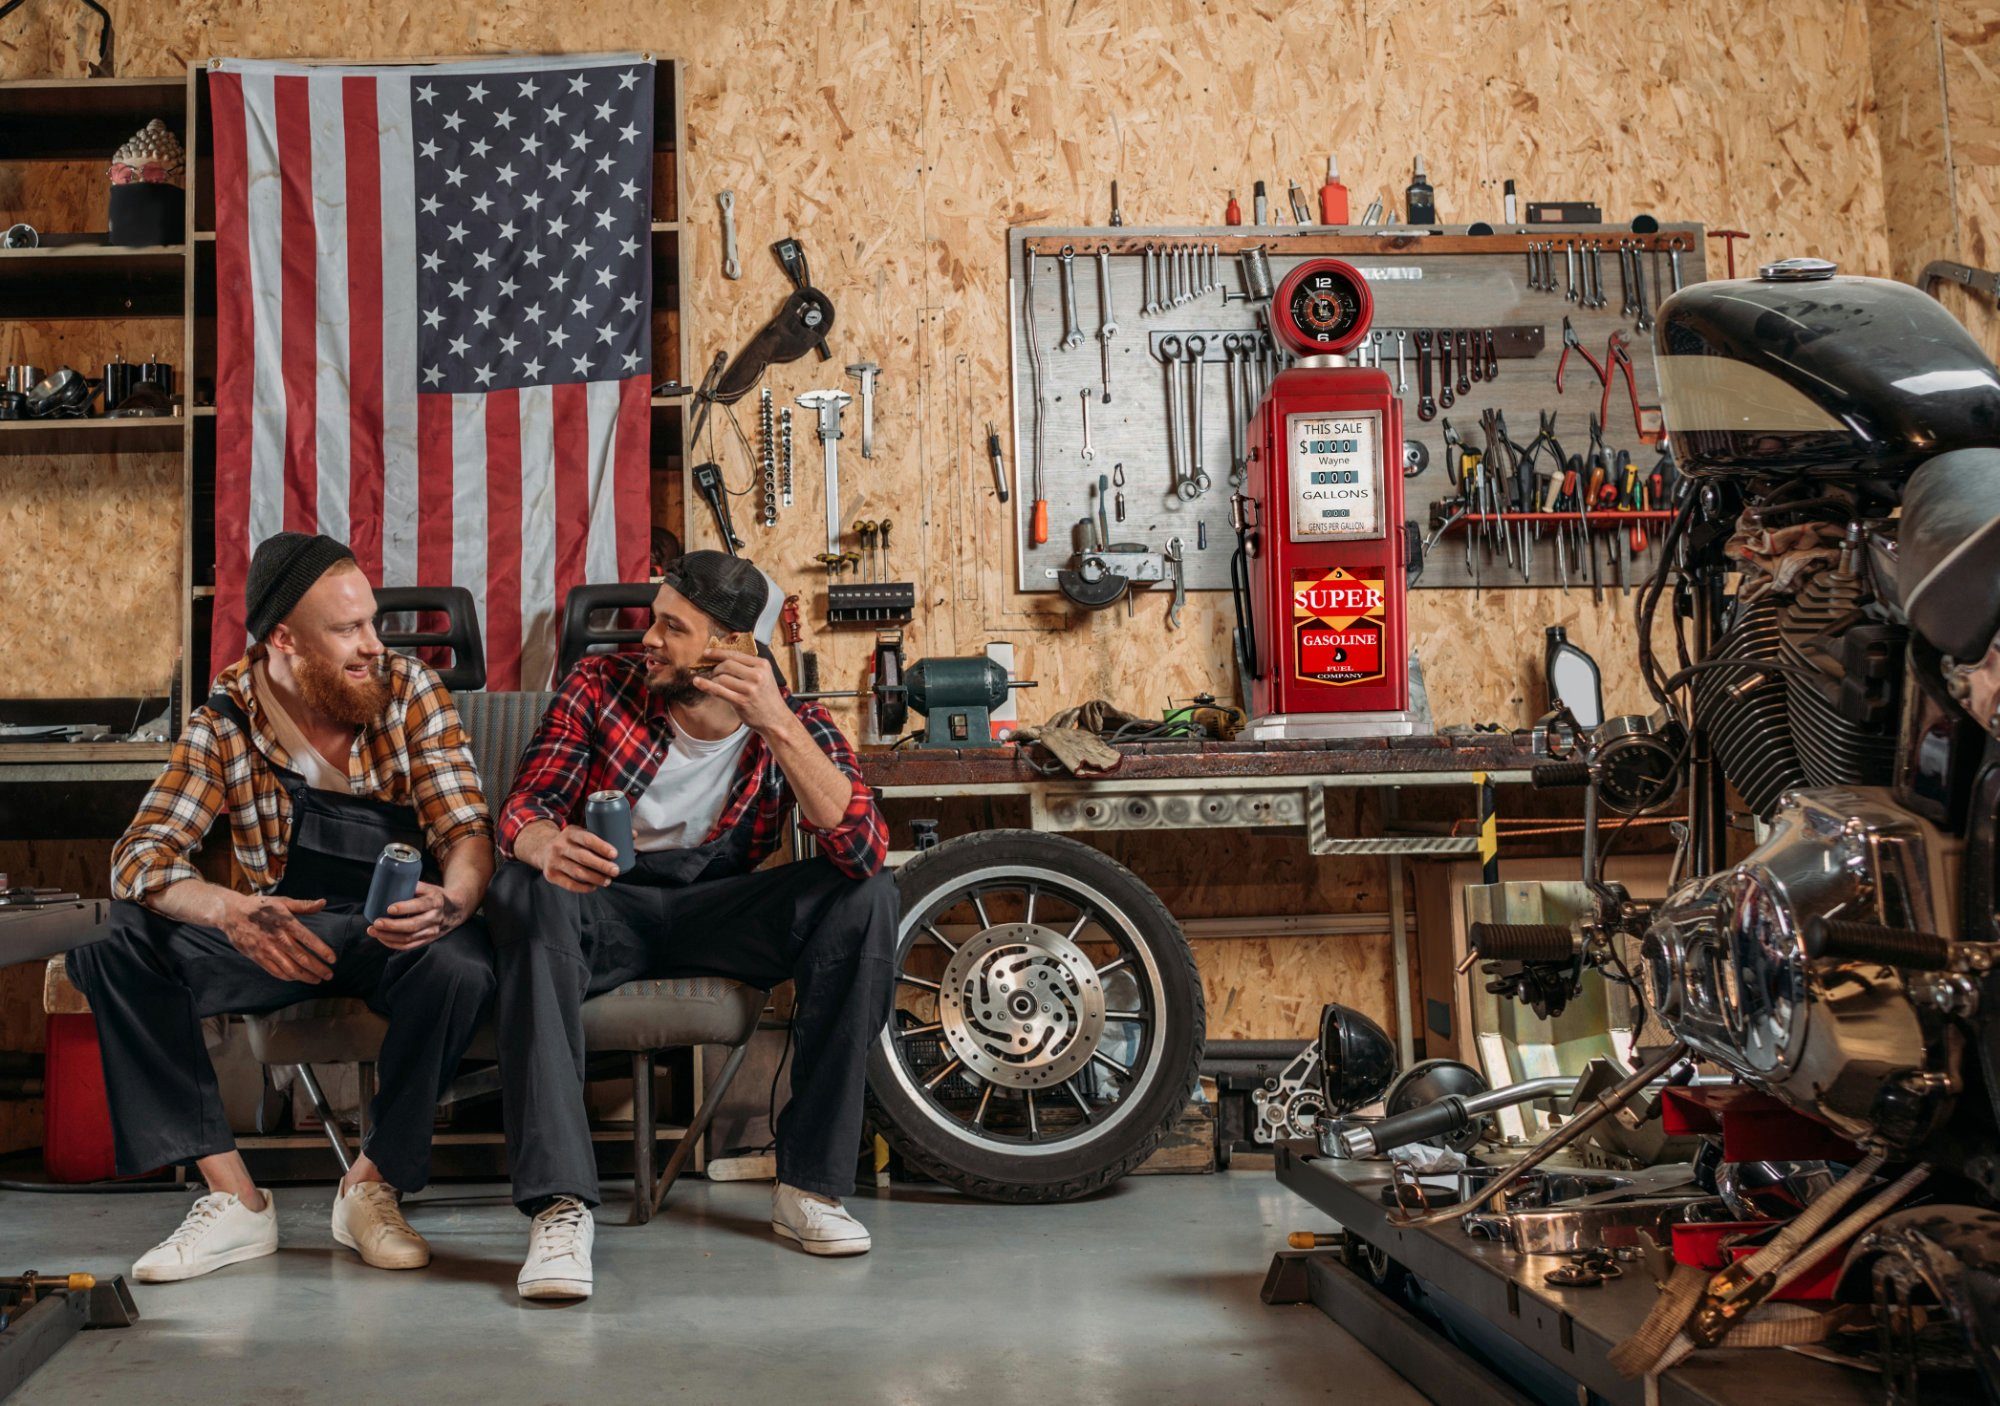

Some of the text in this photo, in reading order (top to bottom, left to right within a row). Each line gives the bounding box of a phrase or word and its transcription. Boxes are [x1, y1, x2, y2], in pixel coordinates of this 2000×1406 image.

[1315, 278, 1332, 288] 12
[1317, 333, 1330, 342] 6
[1304, 423, 1362, 435] THIS SALE
[1319, 457, 1350, 467] Wayne
[1302, 490, 1368, 500] GALLONS
[1329, 522, 1339, 530] PER
[1341, 521, 1364, 530] GALLON
[1295, 589, 1383, 609] SUPER
[1303, 634, 1377, 646] GASOLINE
